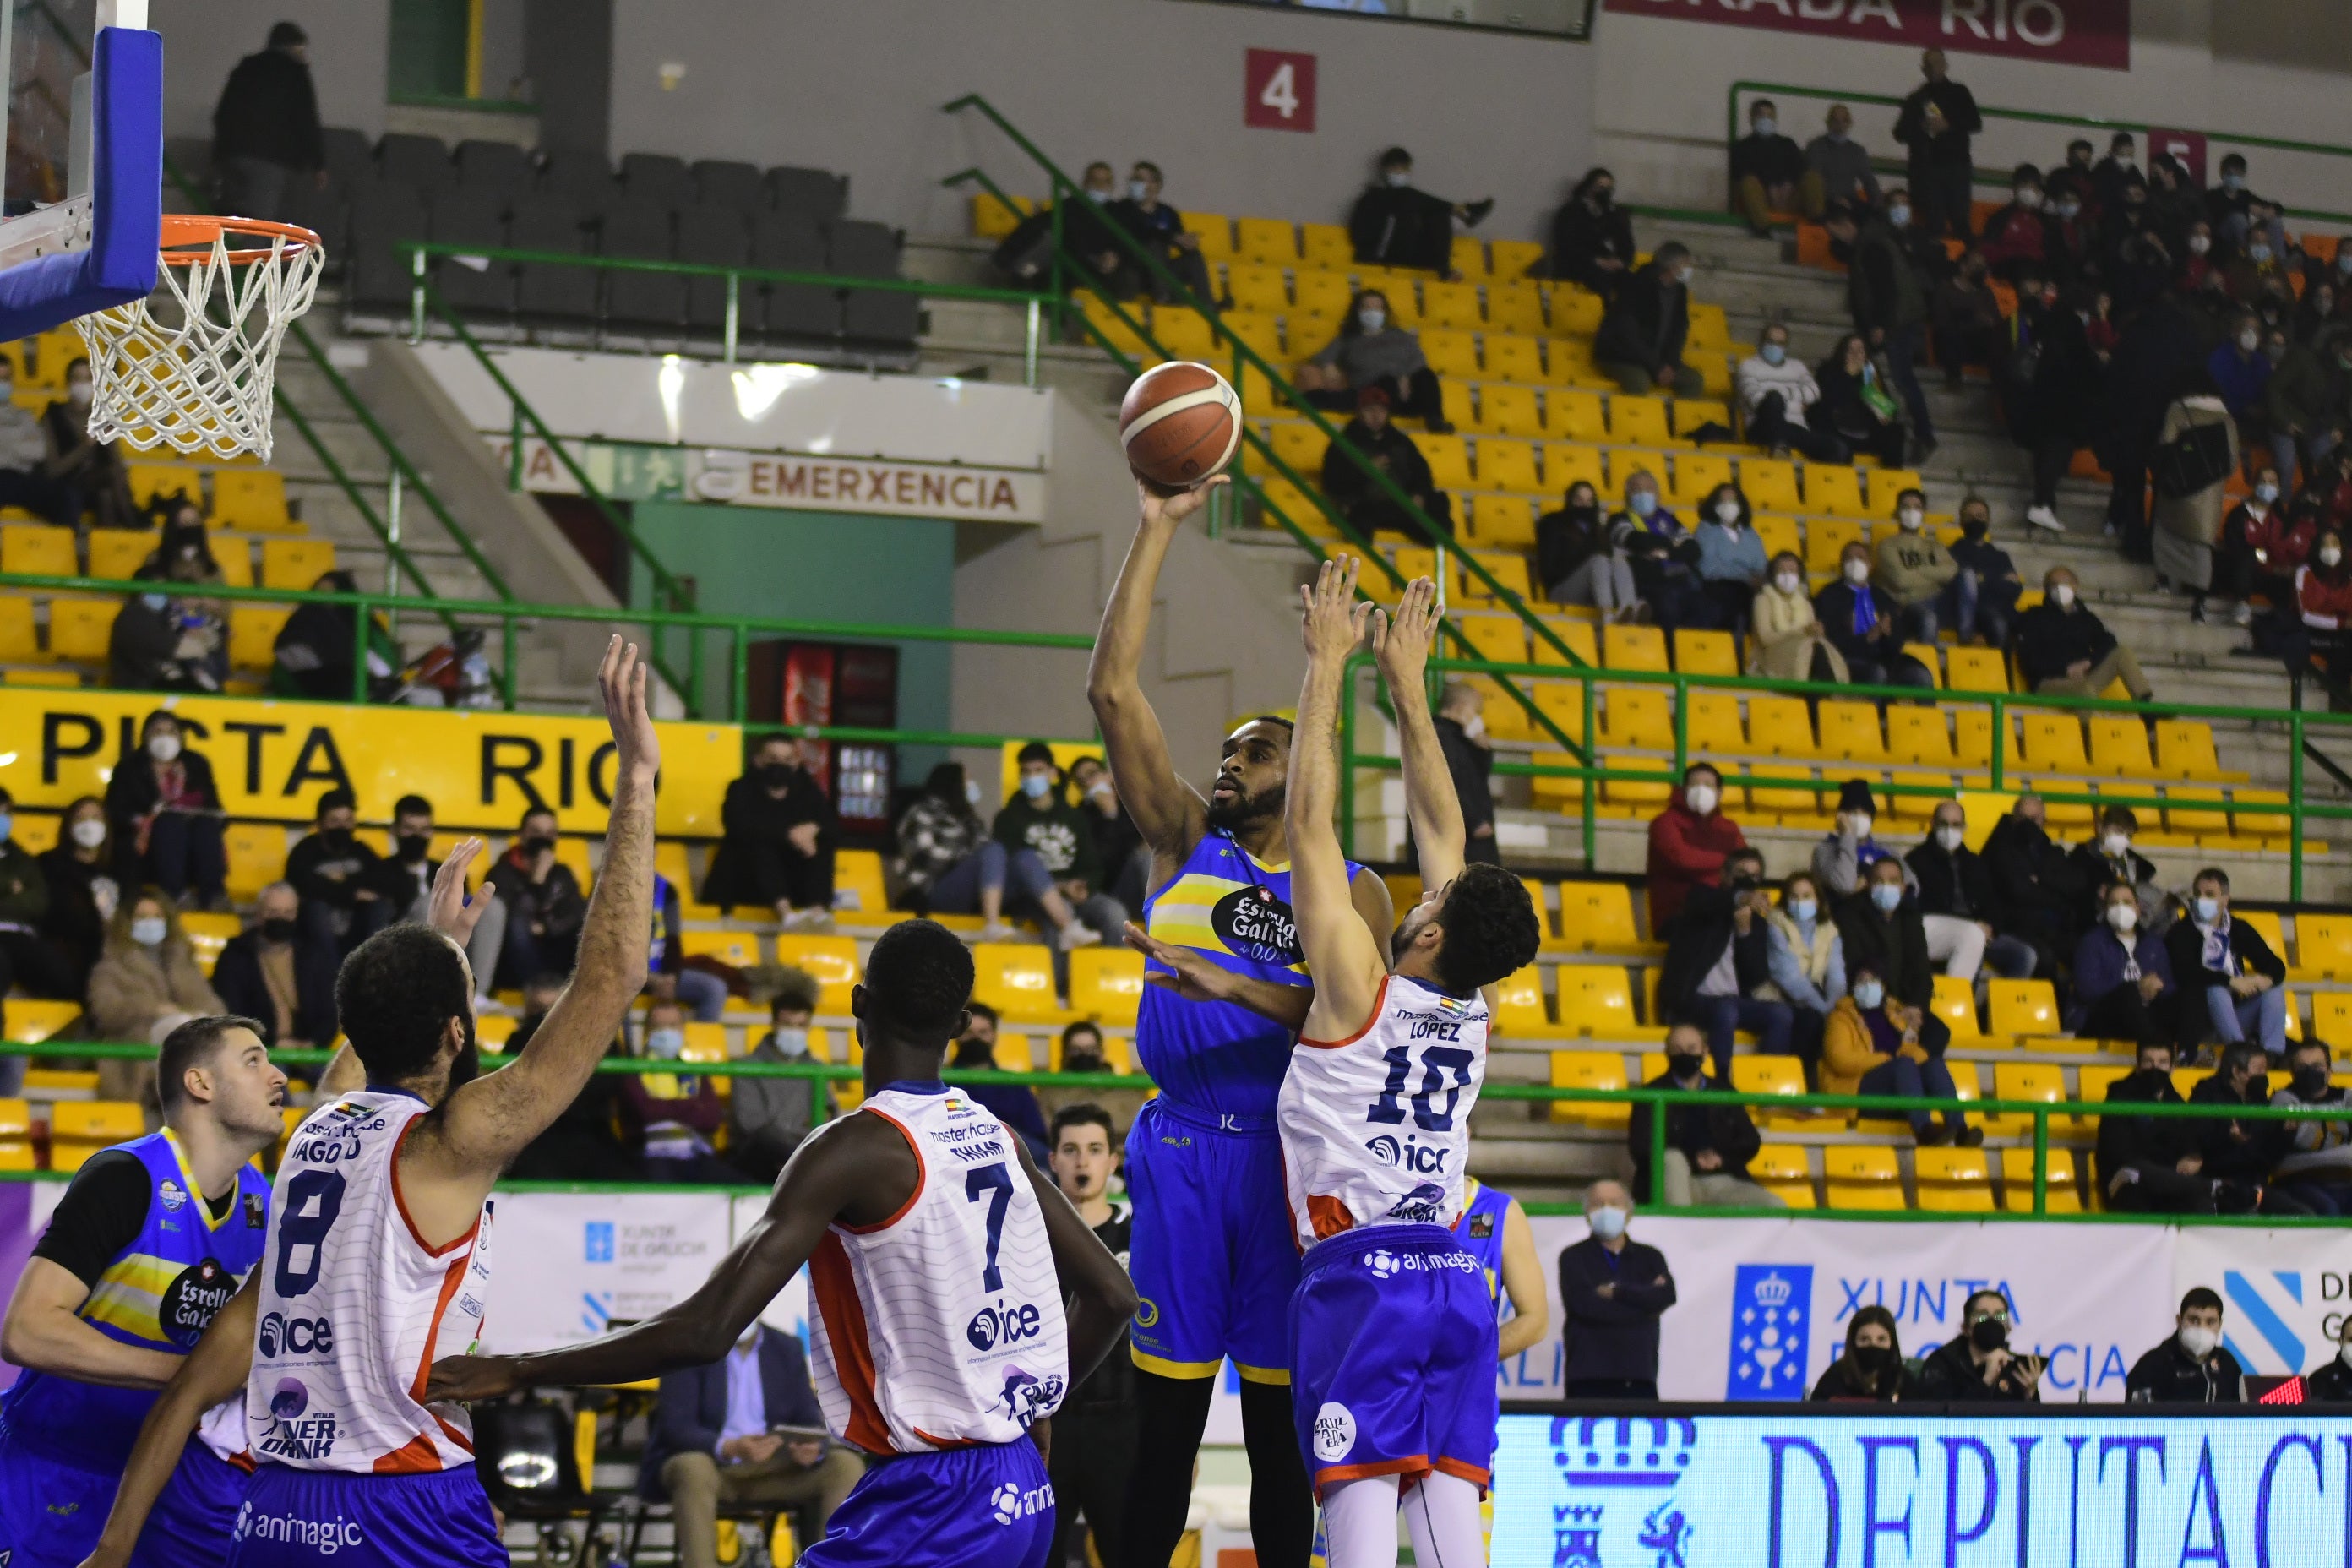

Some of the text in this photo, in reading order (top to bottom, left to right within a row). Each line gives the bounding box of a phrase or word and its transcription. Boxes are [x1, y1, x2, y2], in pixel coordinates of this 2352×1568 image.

[1260, 63, 1299, 119] 4
[749, 460, 1019, 512] EMERXENCIA
[42, 710, 356, 798] PITA
[1366, 1045, 1475, 1132] 10
[275, 1168, 346, 1298] 8
[965, 1162, 1014, 1294] 7
[2321, 1271, 2352, 1301] D
[281, 1317, 334, 1355] ice
[999, 1298, 1040, 1344] ice
[279, 1419, 336, 1440] NER
[256, 1512, 363, 1554] animagic
